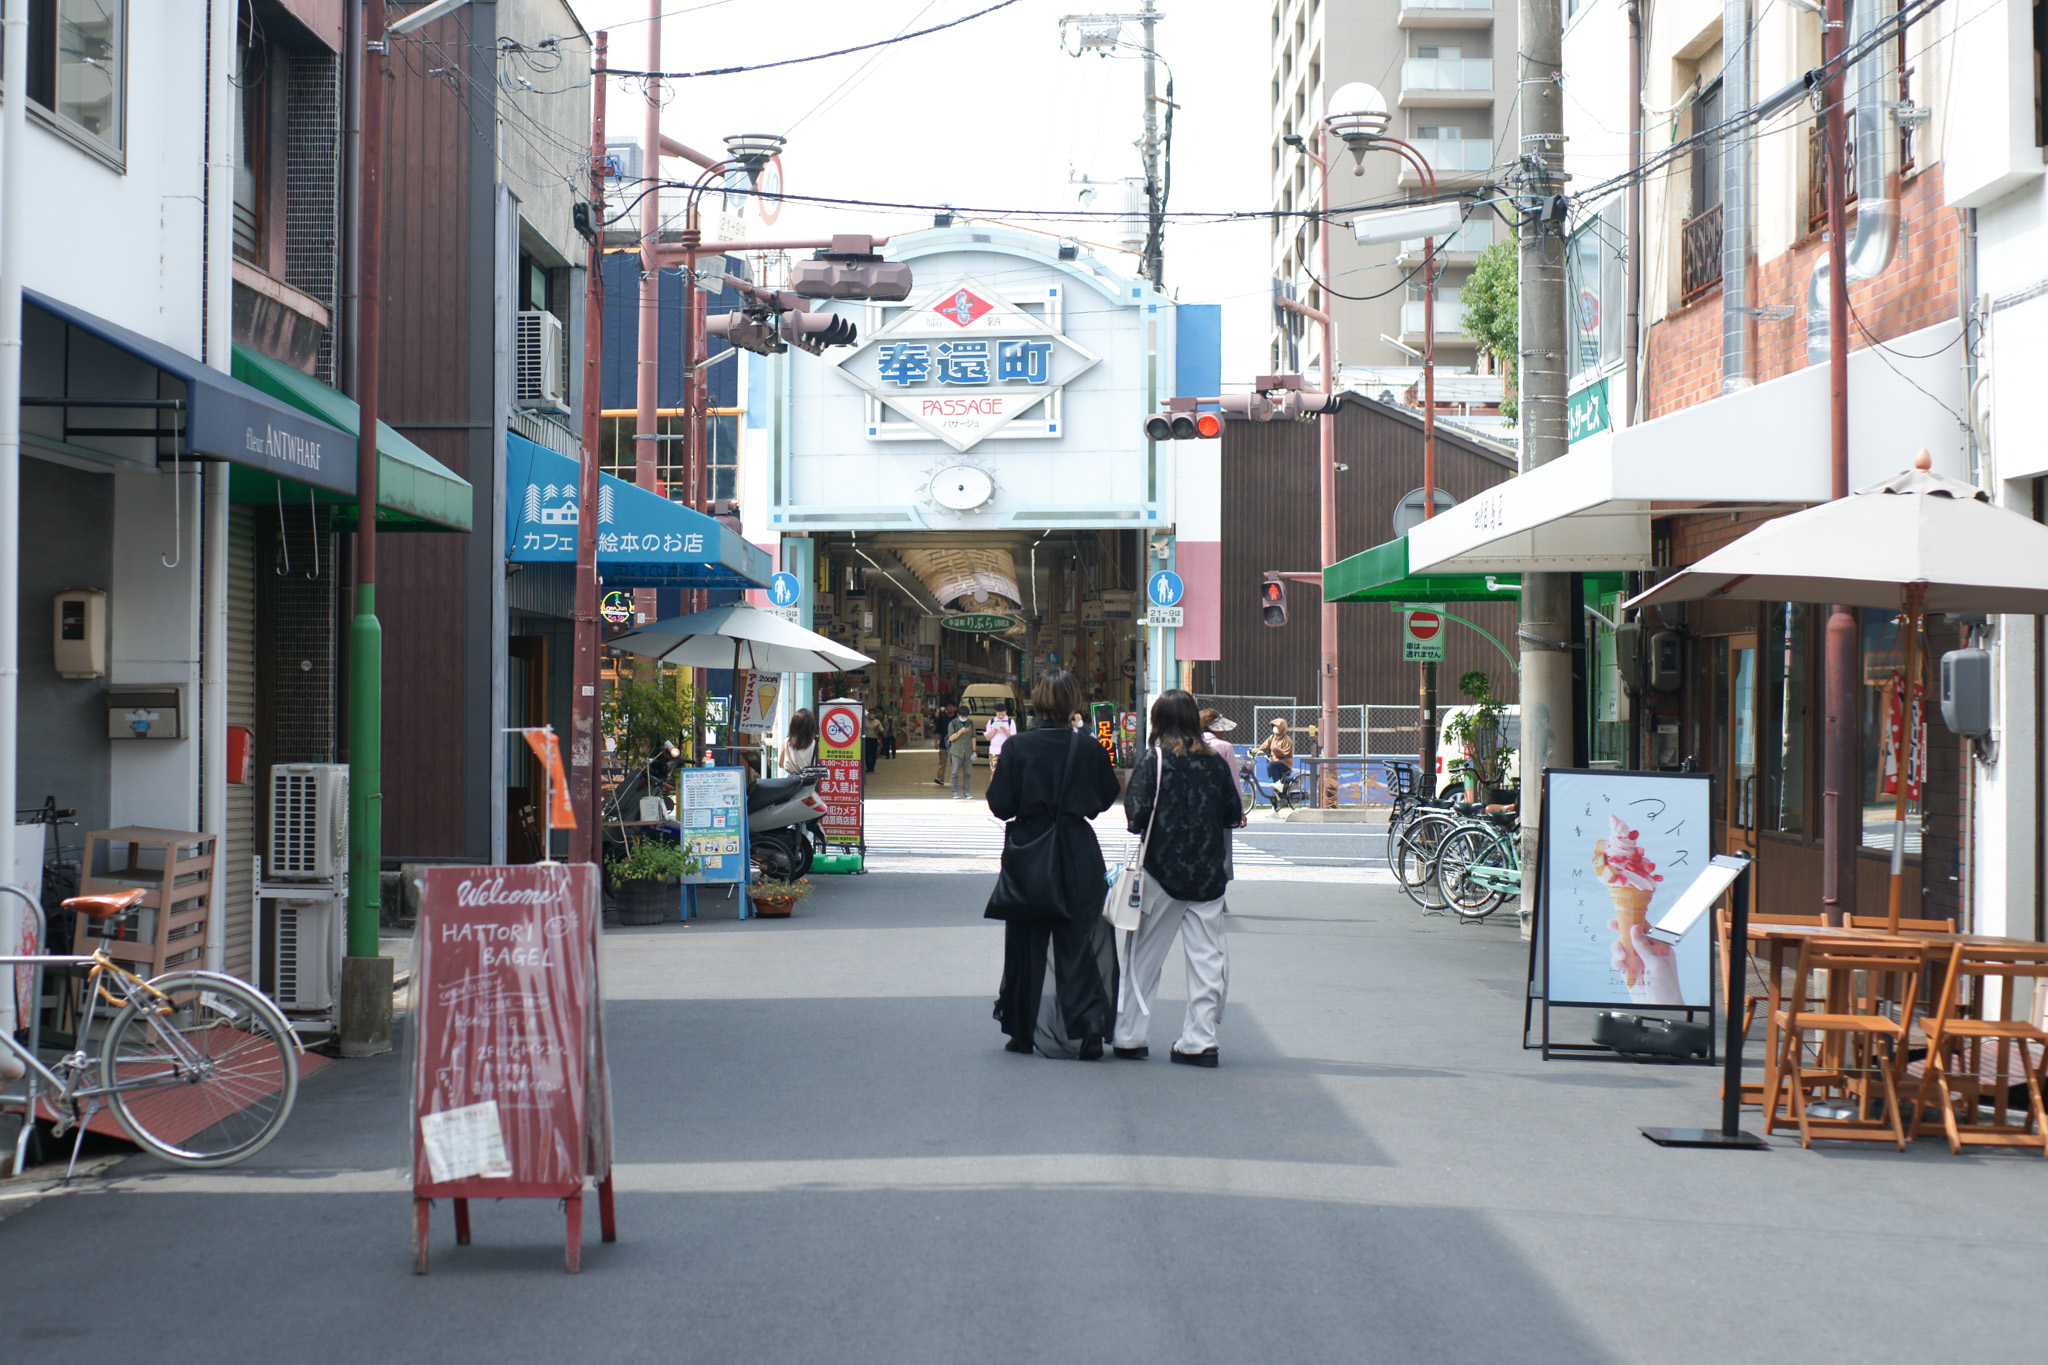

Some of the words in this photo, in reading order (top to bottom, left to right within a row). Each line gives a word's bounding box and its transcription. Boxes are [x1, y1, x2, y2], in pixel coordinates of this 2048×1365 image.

[878, 340, 1054, 387] 奉還町
[922, 398, 1003, 416] PASSAGE
[942, 419, 980, 428] パサージュ
[246, 427, 264, 454] fleur
[266, 423, 321, 470] ANTWHARF
[523, 533, 573, 551] カフェ
[598, 533, 704, 553] 絵本のお店
[967, 616, 993, 630] りぶら
[1406, 642, 1421, 650] 車は
[1406, 650, 1442, 659] 通れません
[759, 675, 778, 683] 200円
[743, 673, 757, 722] アイスクリン
[821, 781, 859, 794] 乗入禁止
[822, 815, 857, 826] 設置商店街
[457, 877, 568, 907] Welcome!
[442, 922, 533, 944] HATTORI
[483, 946, 555, 968] BAGEL
